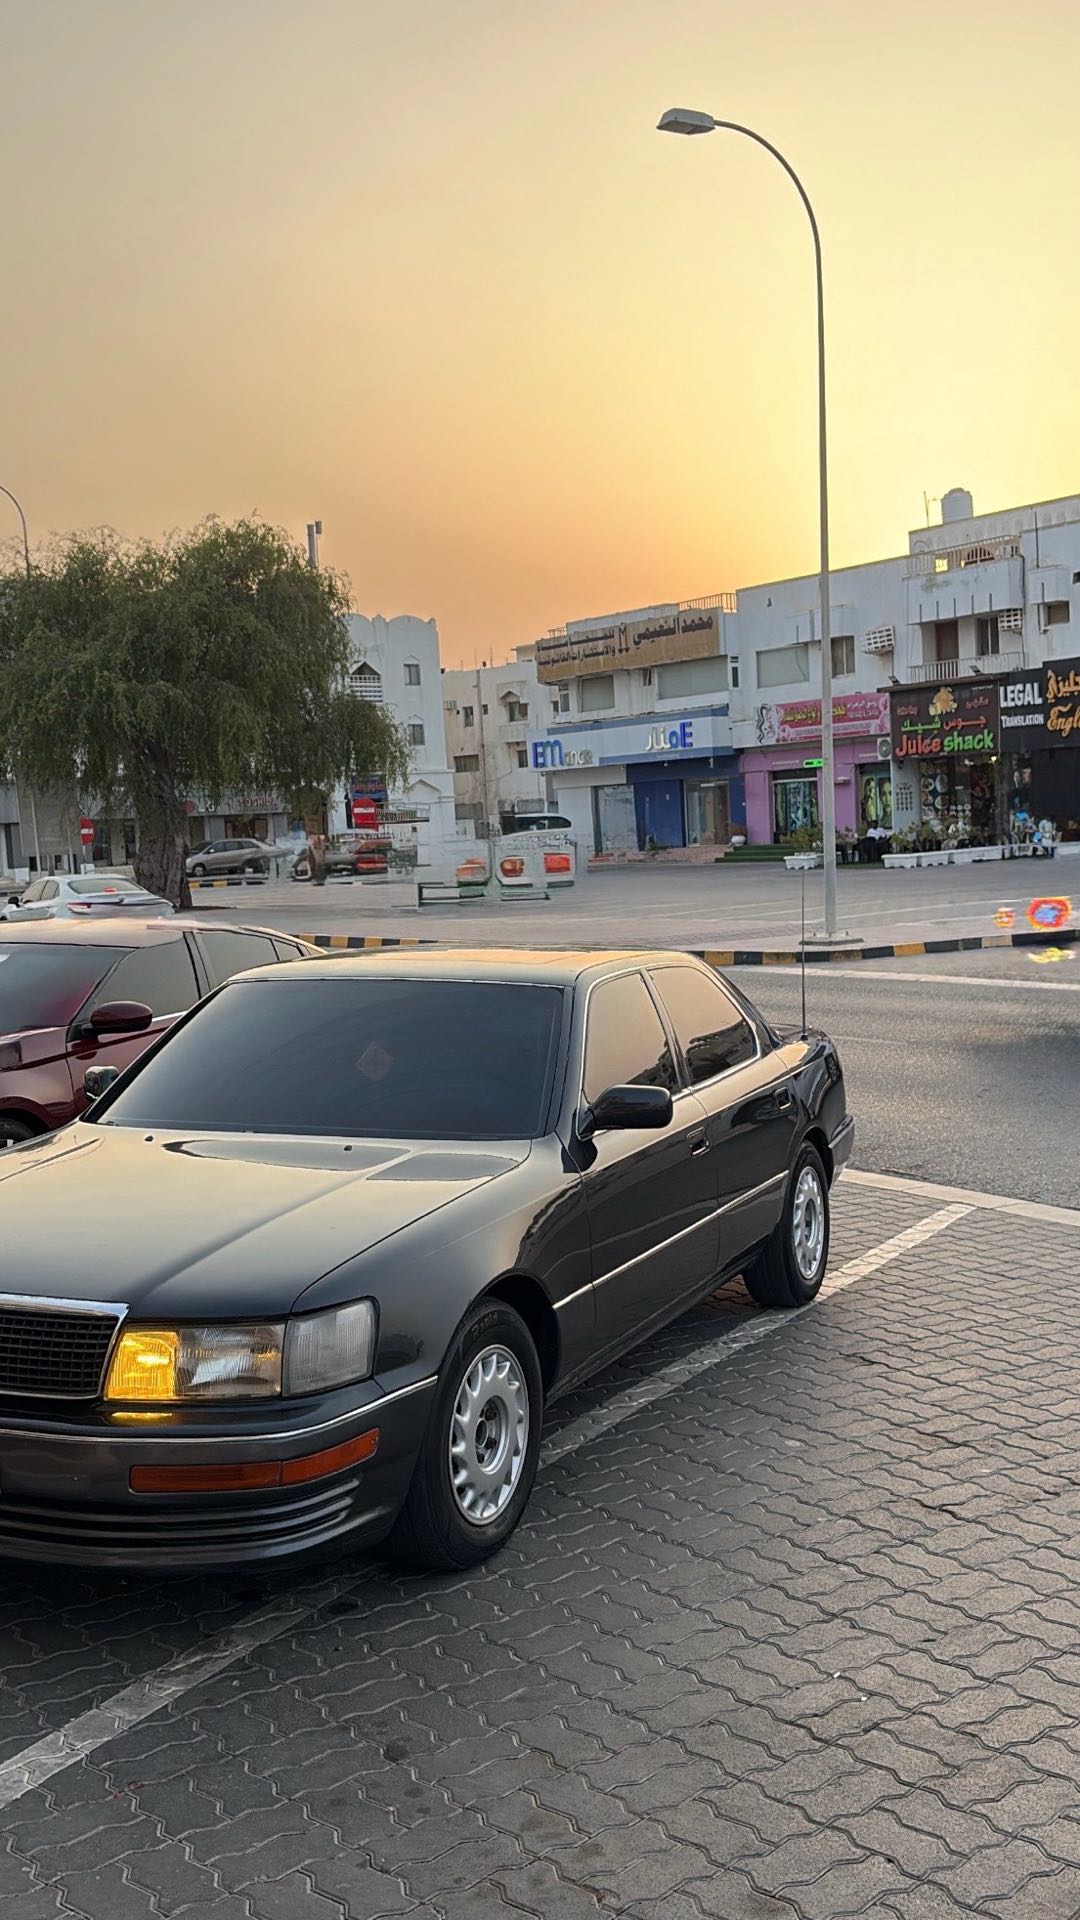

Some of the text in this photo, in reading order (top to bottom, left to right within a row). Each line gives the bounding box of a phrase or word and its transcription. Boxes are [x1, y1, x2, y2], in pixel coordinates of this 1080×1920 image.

[633, 615, 713, 649] محمد النعيمي
[999, 682, 1043, 708] LEGAL
[1001, 713, 1044, 729] TRANSLATION
[895, 729, 994, 757] Juice shack
